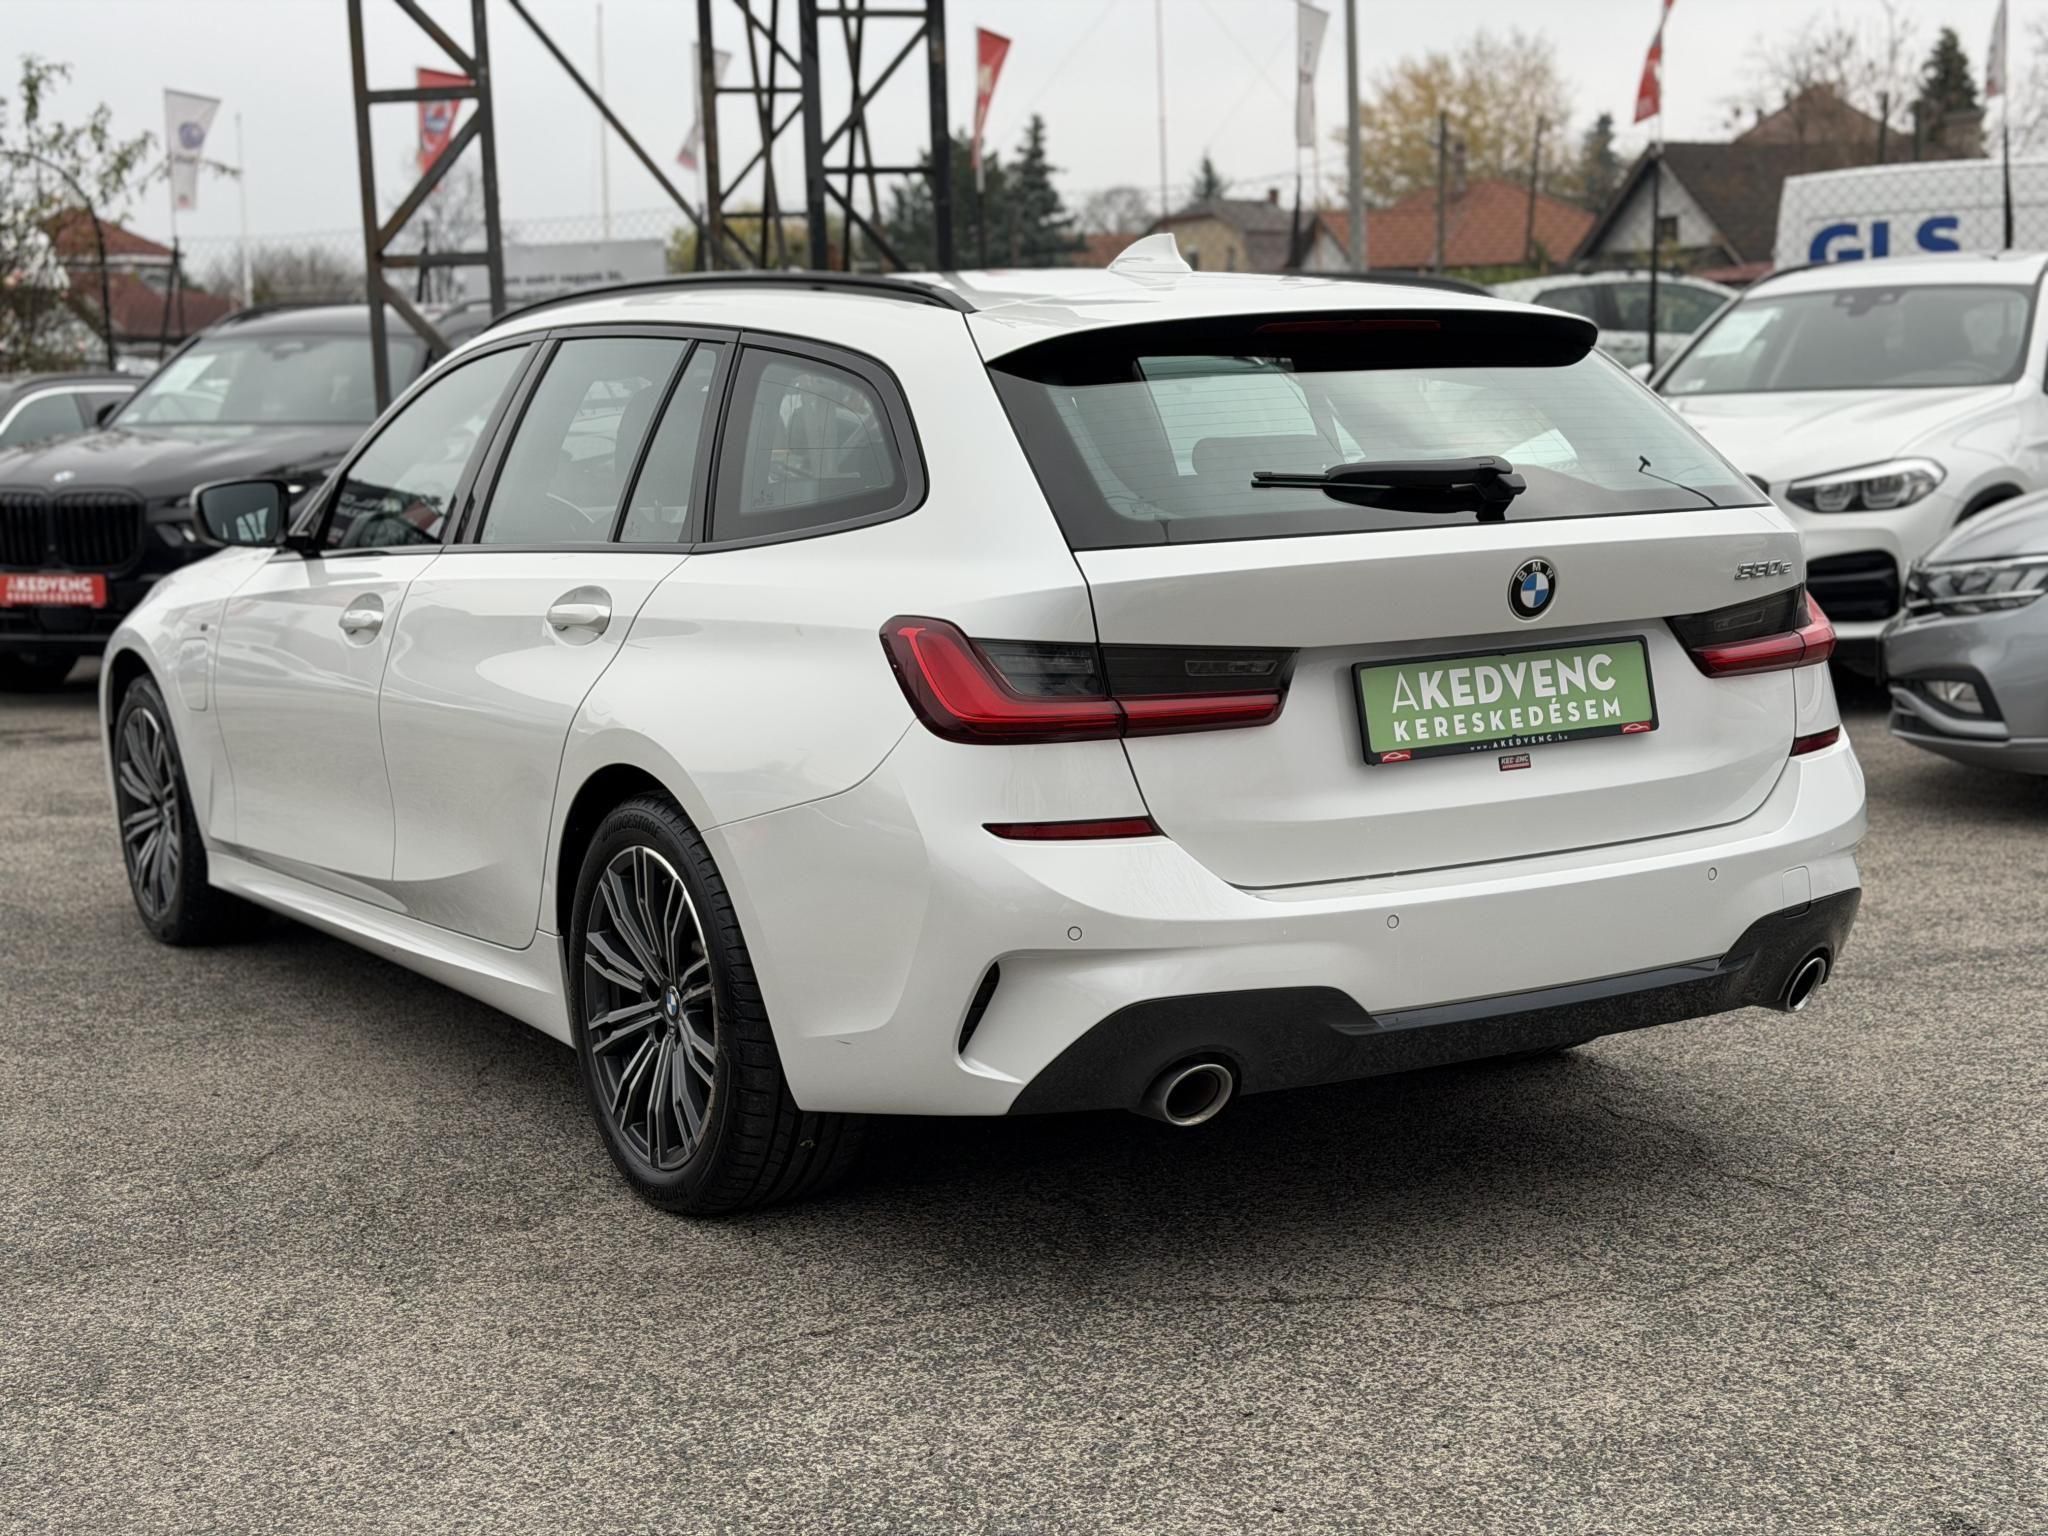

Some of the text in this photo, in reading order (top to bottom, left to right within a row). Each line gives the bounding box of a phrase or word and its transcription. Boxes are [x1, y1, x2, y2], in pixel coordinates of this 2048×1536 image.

[1516, 561, 1554, 582] BMW
[1392, 653, 1617, 714] AKEDVENC
[1393, 696, 1622, 742] KERESKEDÉSEM
